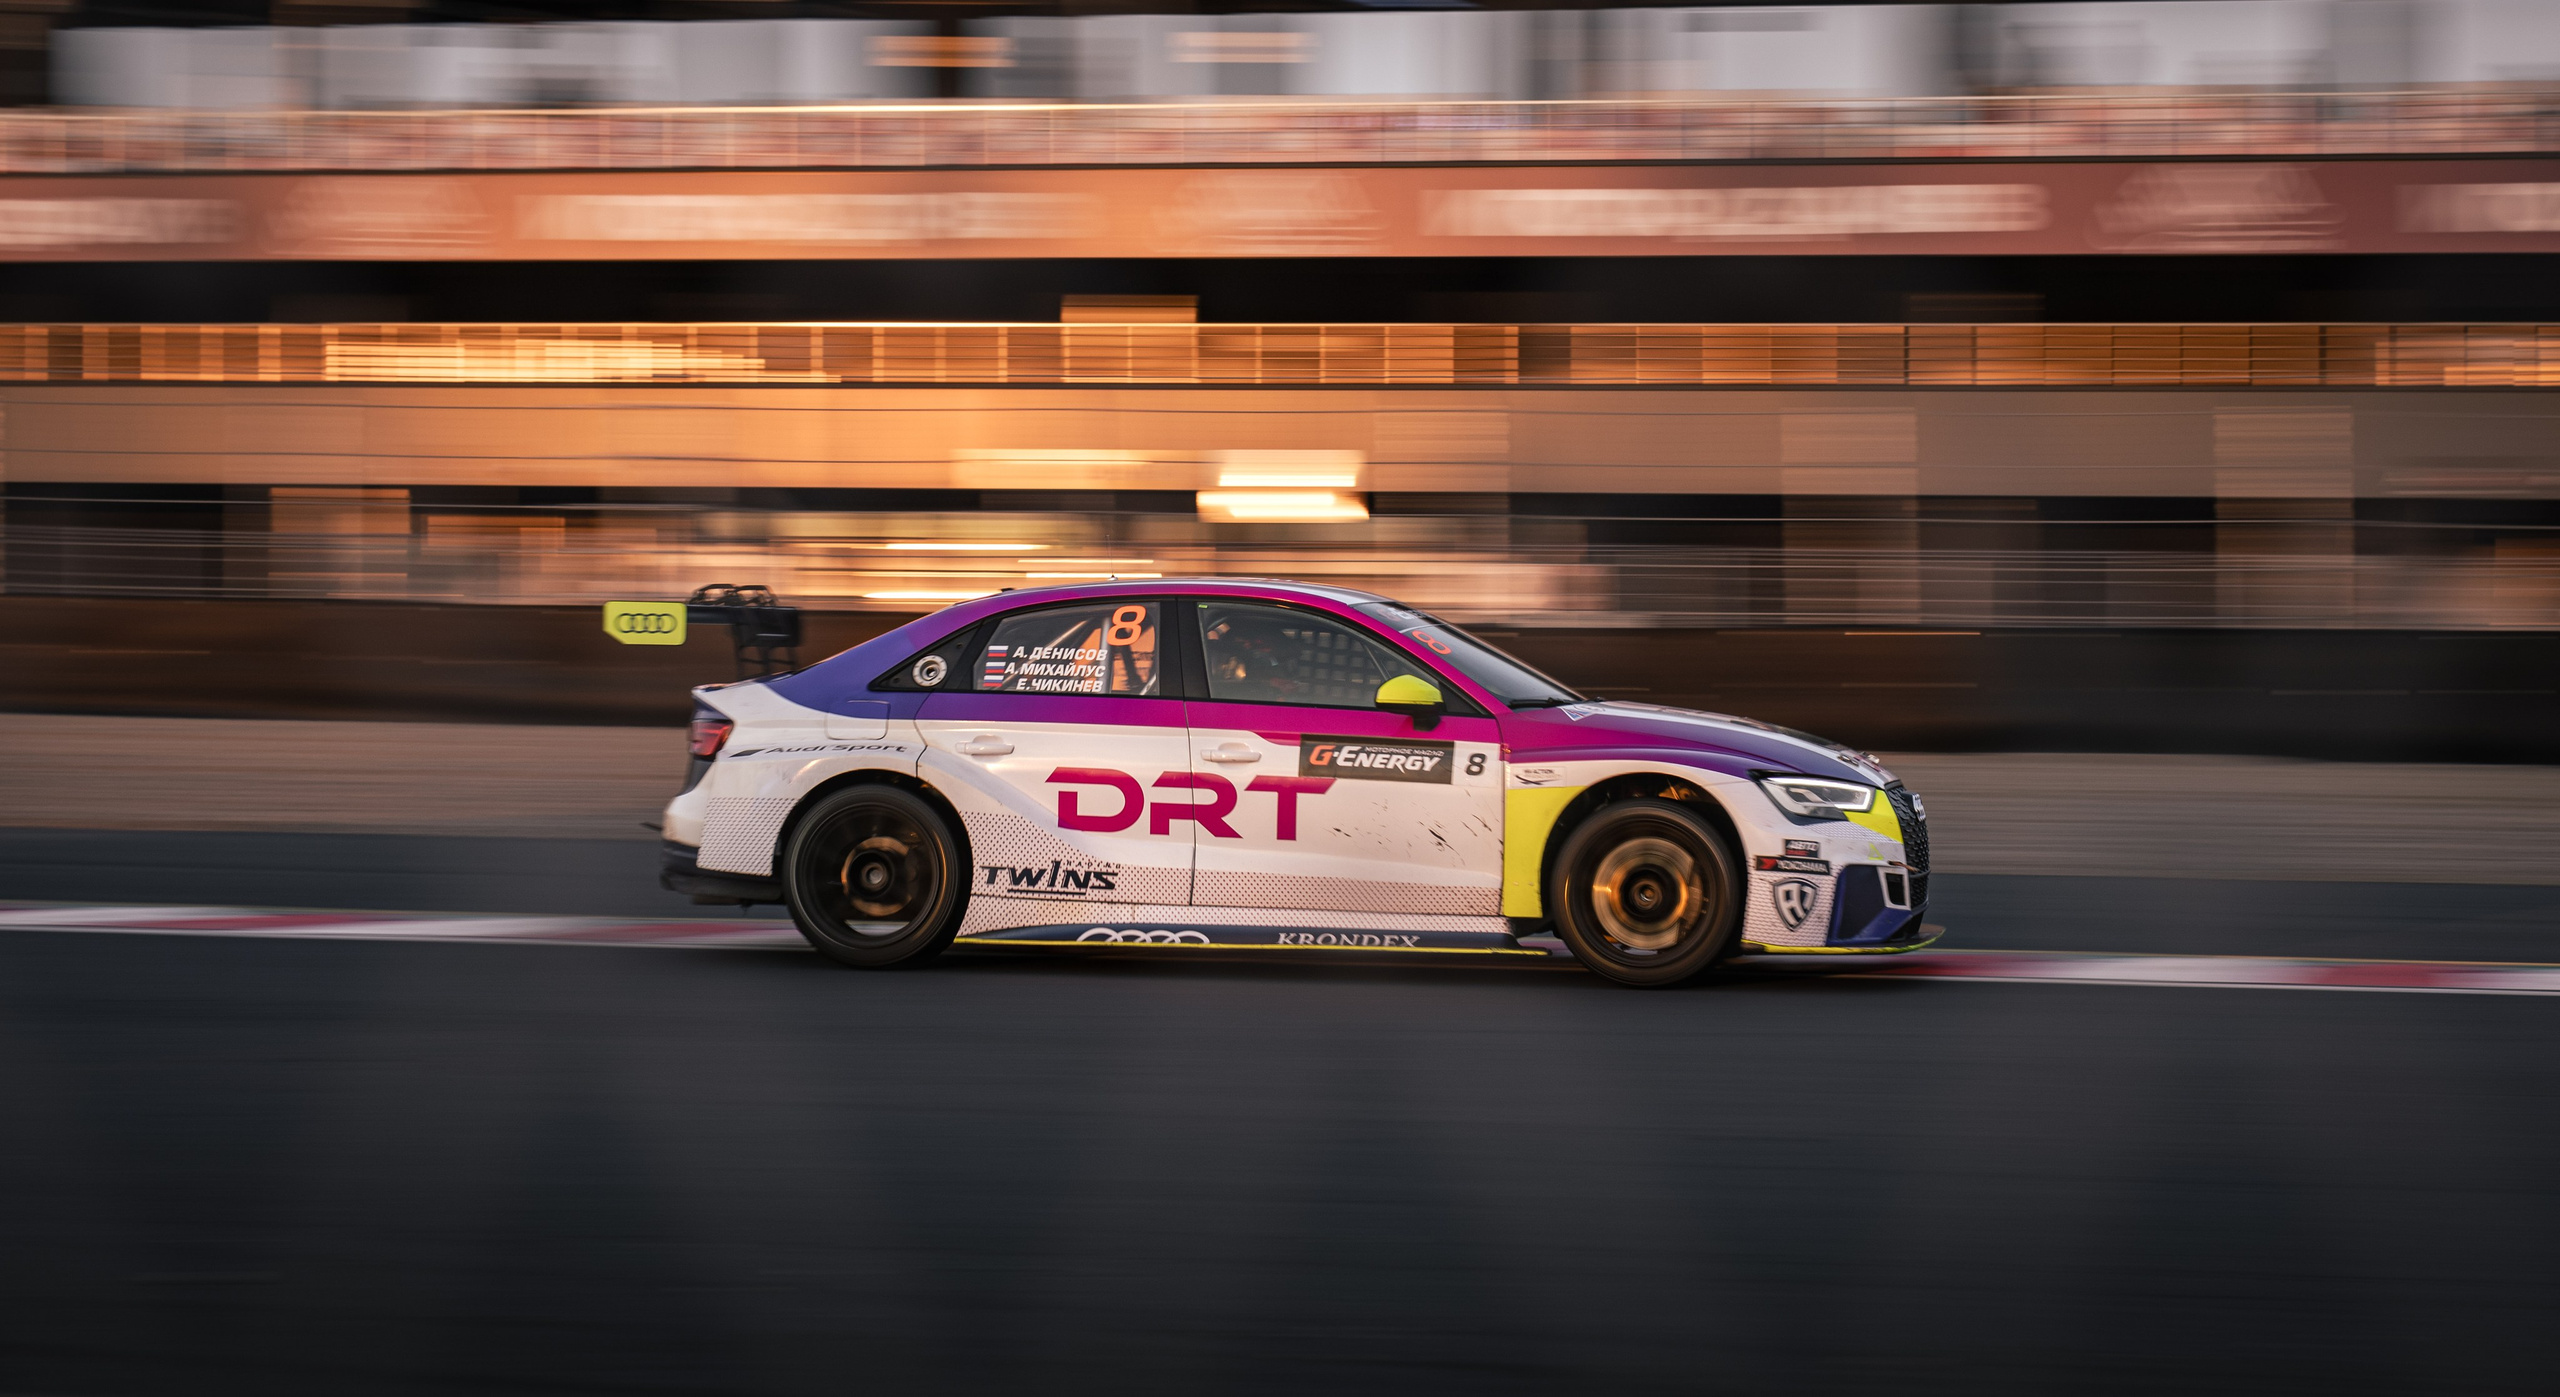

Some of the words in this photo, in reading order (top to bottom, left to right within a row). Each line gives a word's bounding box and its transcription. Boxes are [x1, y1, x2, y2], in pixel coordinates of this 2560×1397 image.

[1106, 605, 1147, 646] 8
[1012, 645, 1028, 659] А.
[1029, 646, 1108, 661] ДЕНИСОВ
[1411, 630, 1452, 655] 8
[765, 745, 828, 754] Audi
[831, 744, 908, 753] Sport
[1465, 753, 1487, 776] 8
[1045, 766, 1337, 841] DRT
[1277, 932, 1421, 948] KRONDEX
